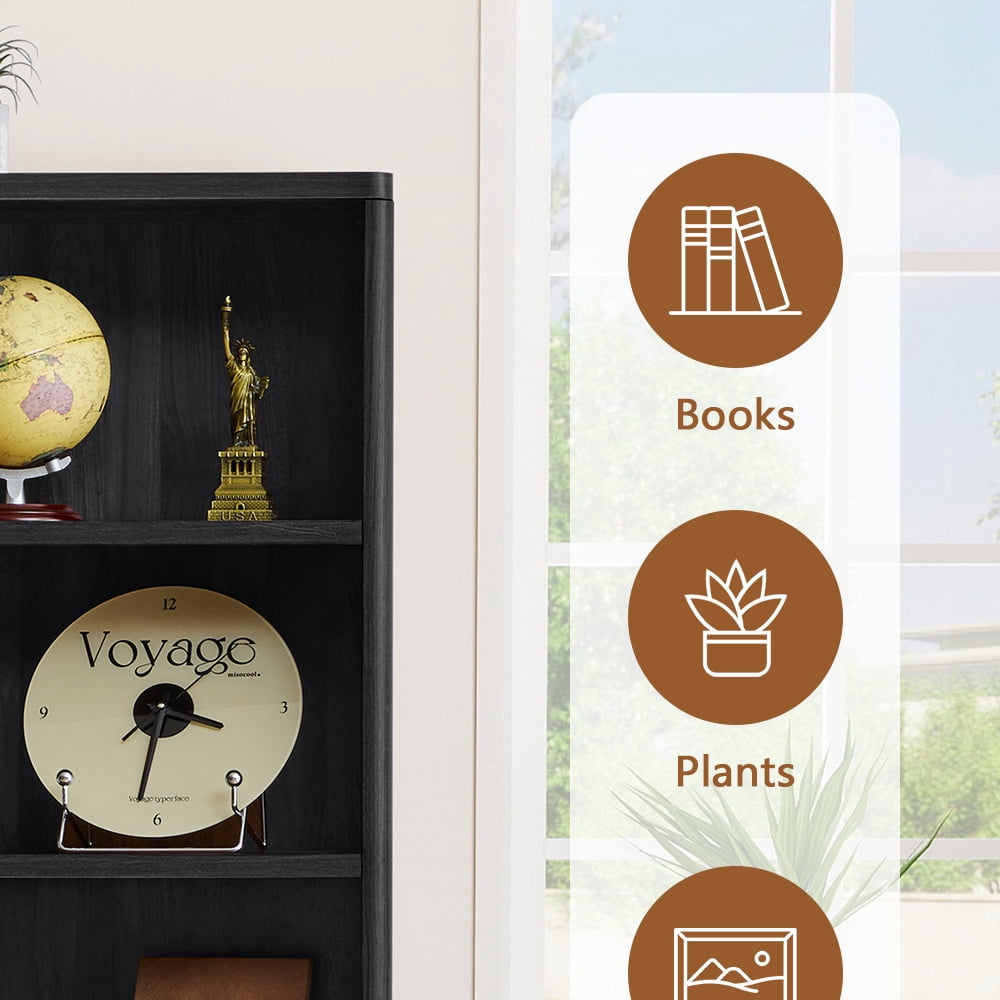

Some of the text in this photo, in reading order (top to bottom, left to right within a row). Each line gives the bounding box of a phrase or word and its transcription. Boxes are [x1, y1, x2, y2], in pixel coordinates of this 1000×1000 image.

[162, 597, 177, 611] 12
[79, 630, 257, 678] Voyage
[39, 706, 49, 720] 9
[279, 701, 288, 714] 3
[152, 812, 162, 826] 6
